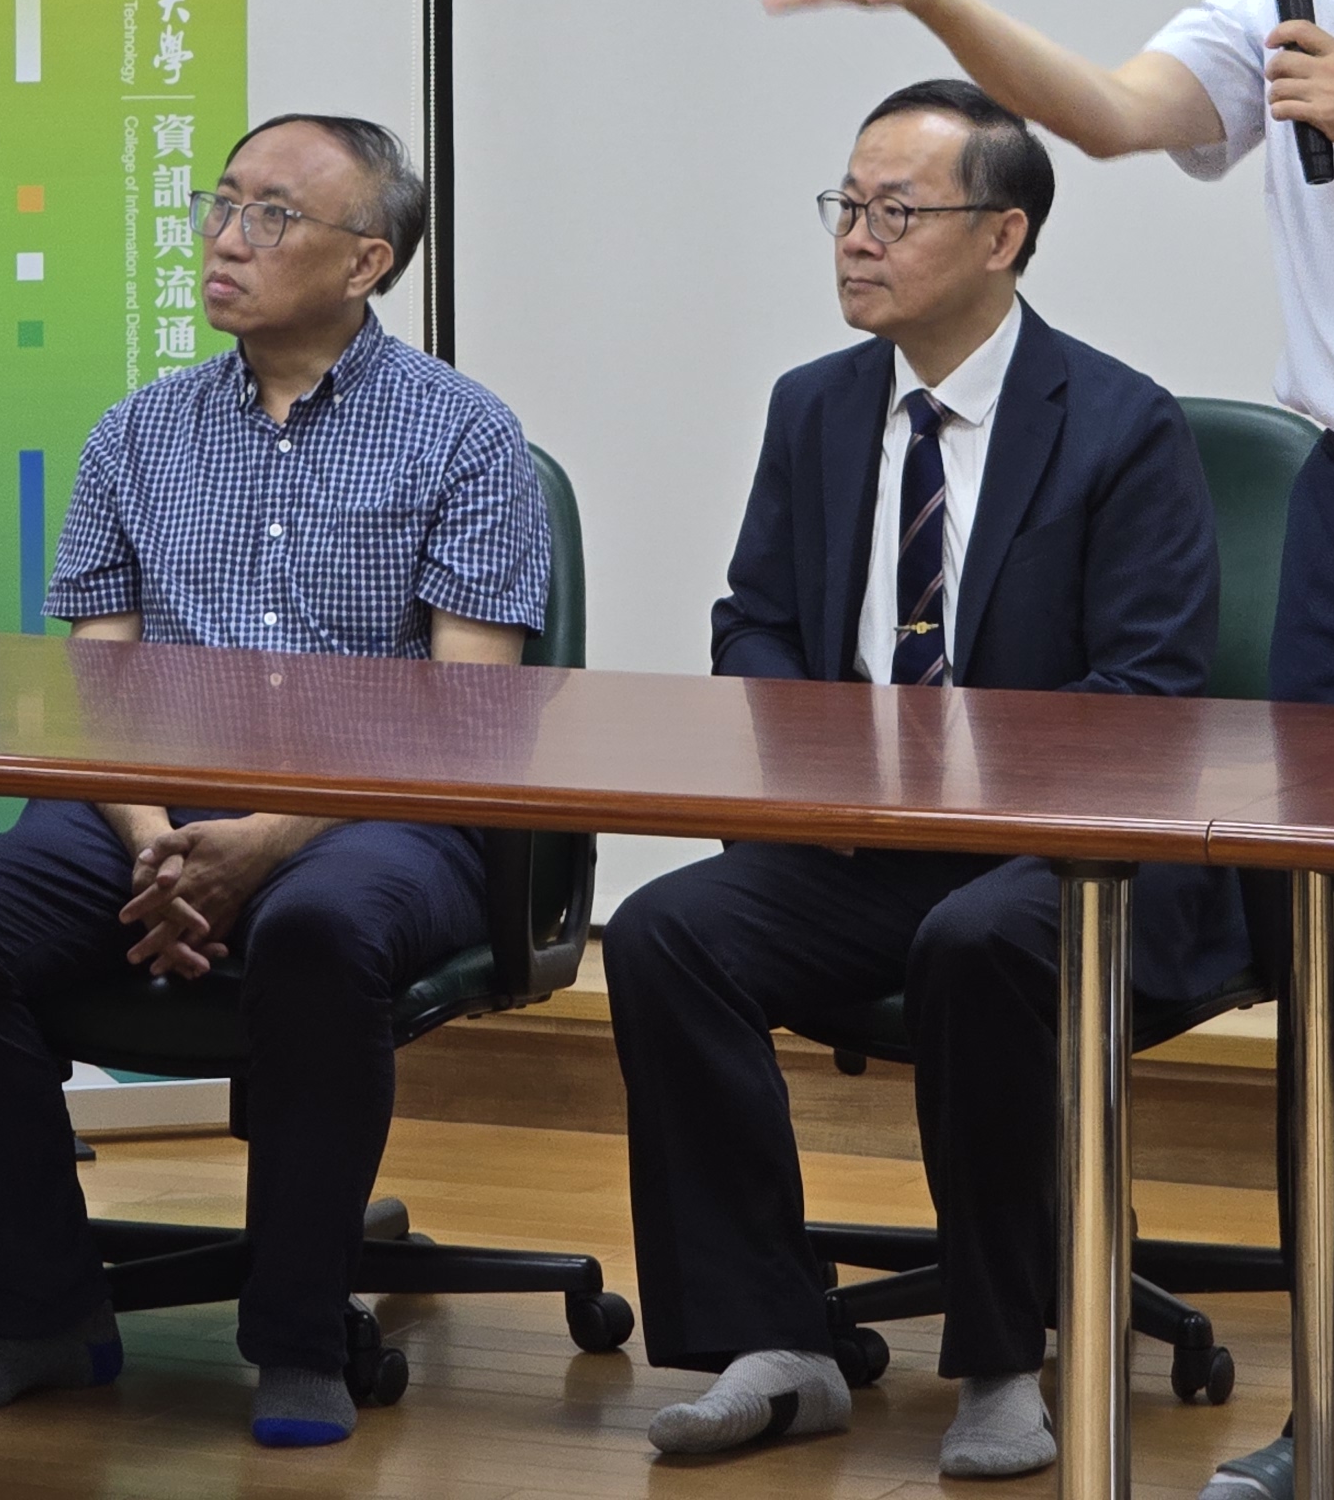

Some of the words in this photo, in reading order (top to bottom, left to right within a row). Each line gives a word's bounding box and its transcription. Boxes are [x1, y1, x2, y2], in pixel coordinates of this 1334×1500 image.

[120, 0, 139, 84] Technology
[121, 116, 139, 172] College
[125, 175, 139, 191] of
[125, 194, 140, 278] Information
[125, 282, 140, 309] and
